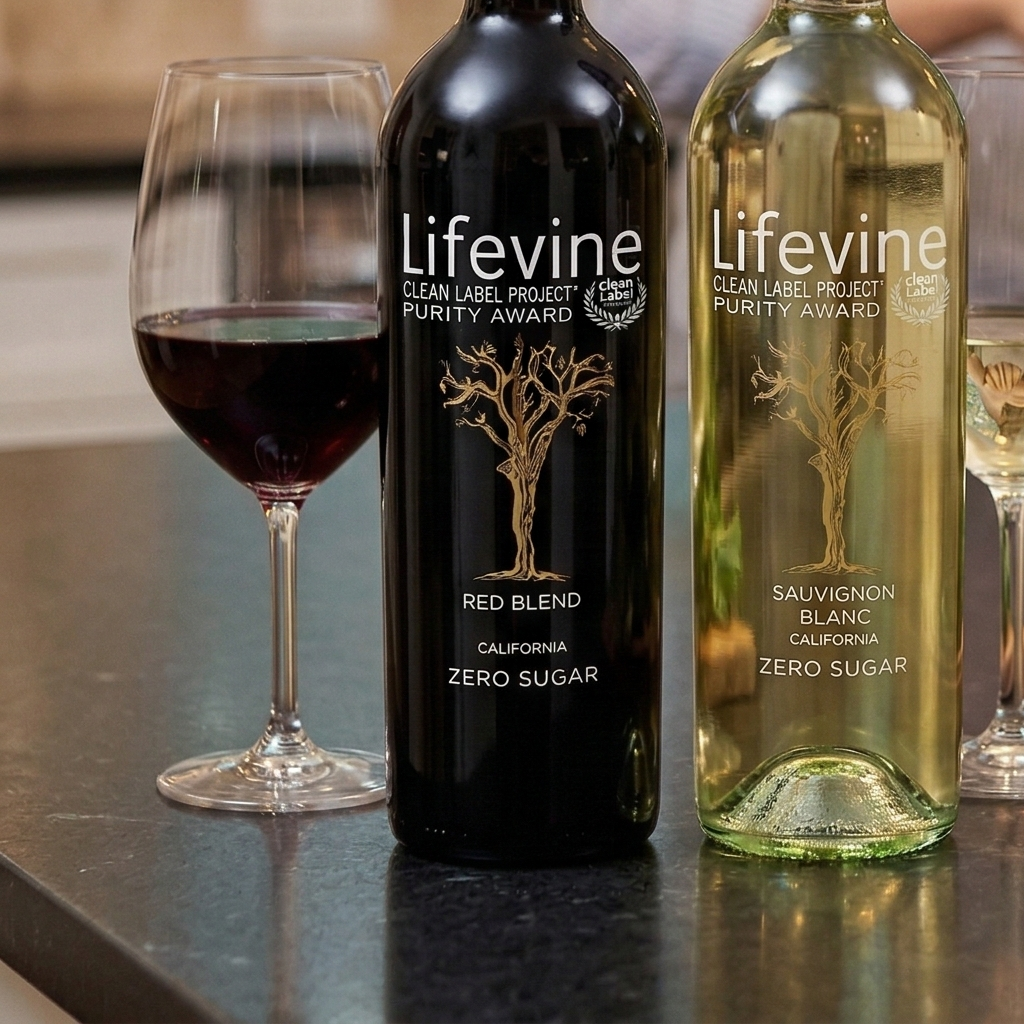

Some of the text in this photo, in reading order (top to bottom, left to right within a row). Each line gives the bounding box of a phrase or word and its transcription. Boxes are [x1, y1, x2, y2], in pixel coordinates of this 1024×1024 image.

[403, 213, 641, 280] Lifevine
[714, 209, 947, 275] Lifevine
[599, 278, 633, 291] clean
[714, 275, 757, 295] CLEAN
[764, 280, 811, 298] LABEL
[905, 272, 937, 287] clean
[403, 281, 449, 301] CLEAN
[456, 285, 503, 303] LABEL
[404, 303, 572, 323] PURITY AWARD
[714, 297, 880, 318] PURITY AWARD
[463, 592, 581, 611] RED BLEND
[772, 584, 895, 602] SAUVIGNON
[800, 609, 871, 625] BLANC
[478, 641, 567, 654] CALIFORNIA
[790, 633, 878, 645] CALIFORNIA
[448, 666, 598, 687] ZERO SUGAR
[759, 657, 907, 678] ZERO SUGAR
